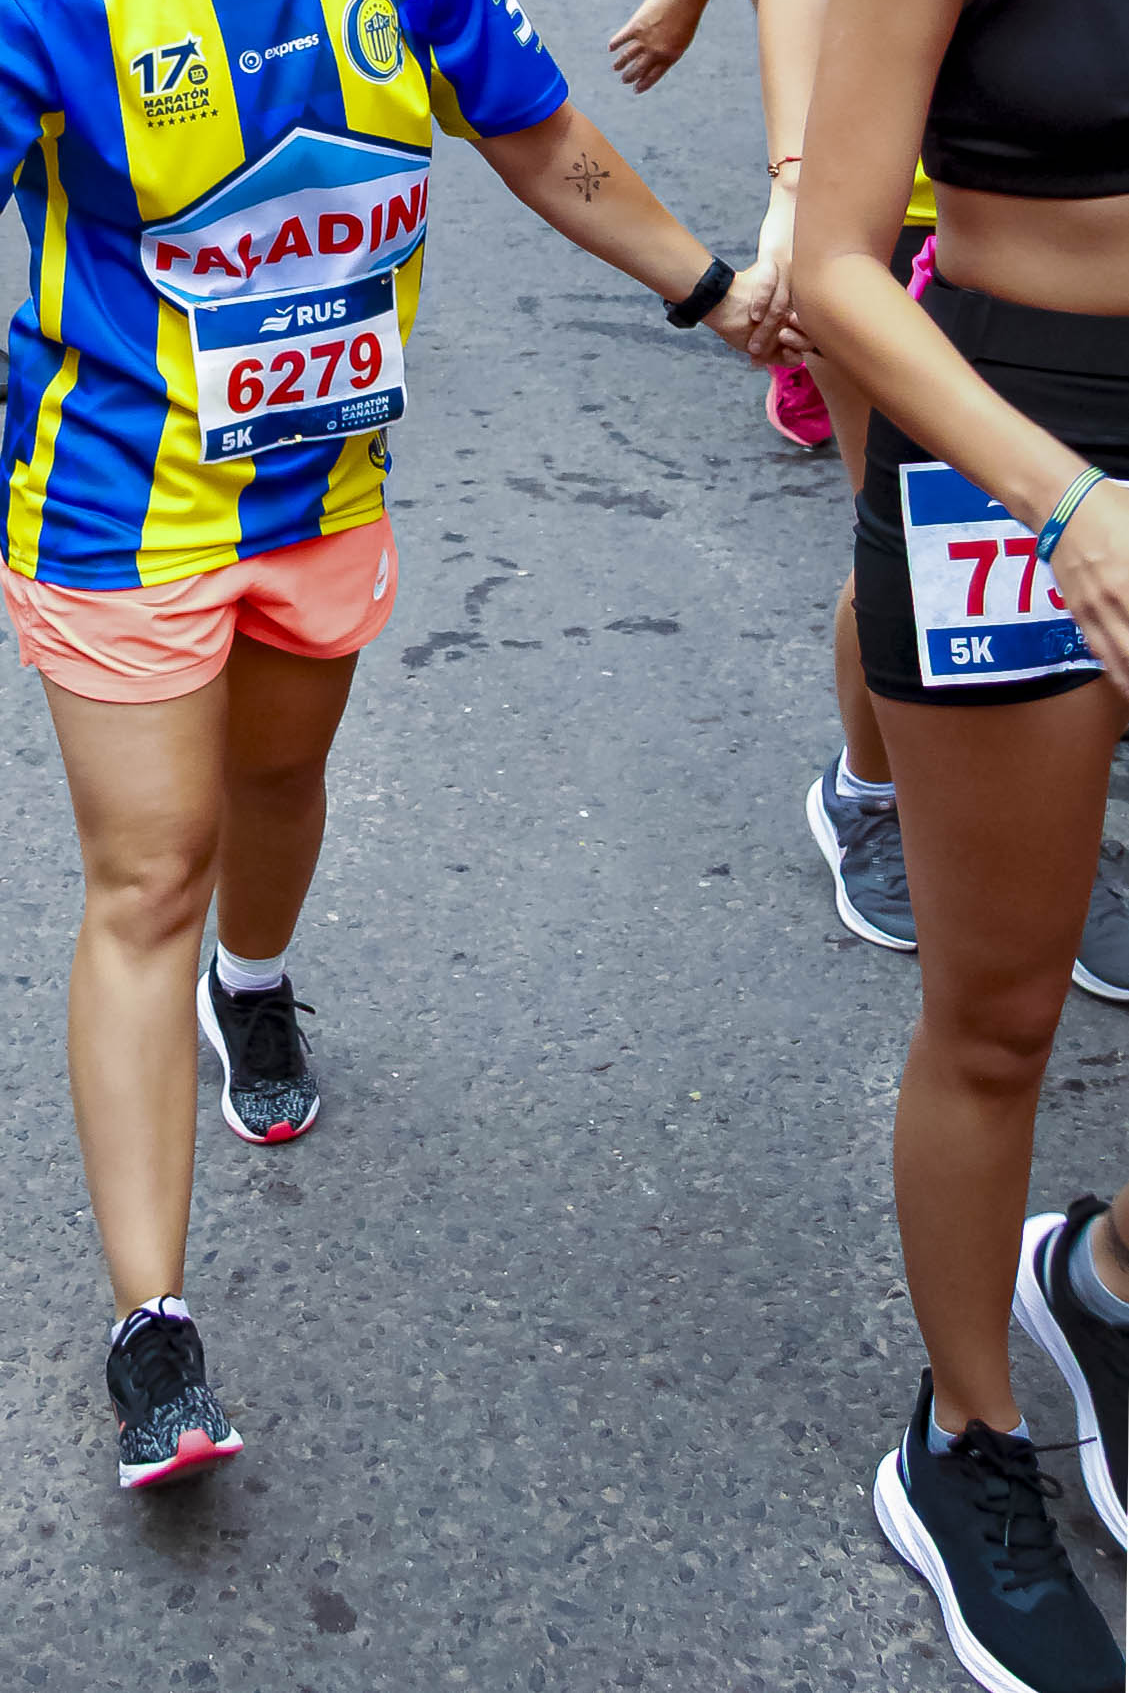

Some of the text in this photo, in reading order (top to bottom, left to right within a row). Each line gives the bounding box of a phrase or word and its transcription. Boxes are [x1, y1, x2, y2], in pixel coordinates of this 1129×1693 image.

[264, 32, 320, 60] express
[130, 32, 206, 97] 17
[143, 87, 210, 109] MARATÓN
[146, 98, 210, 118] CANALLA
[297, 299, 347, 326] RUS
[227, 332, 383, 414] 6279
[341, 395, 389, 414] MARATÓN
[342, 404, 389, 420] CANALLA
[222, 426, 253, 450] 5K
[950, 635, 995, 665] 5K
